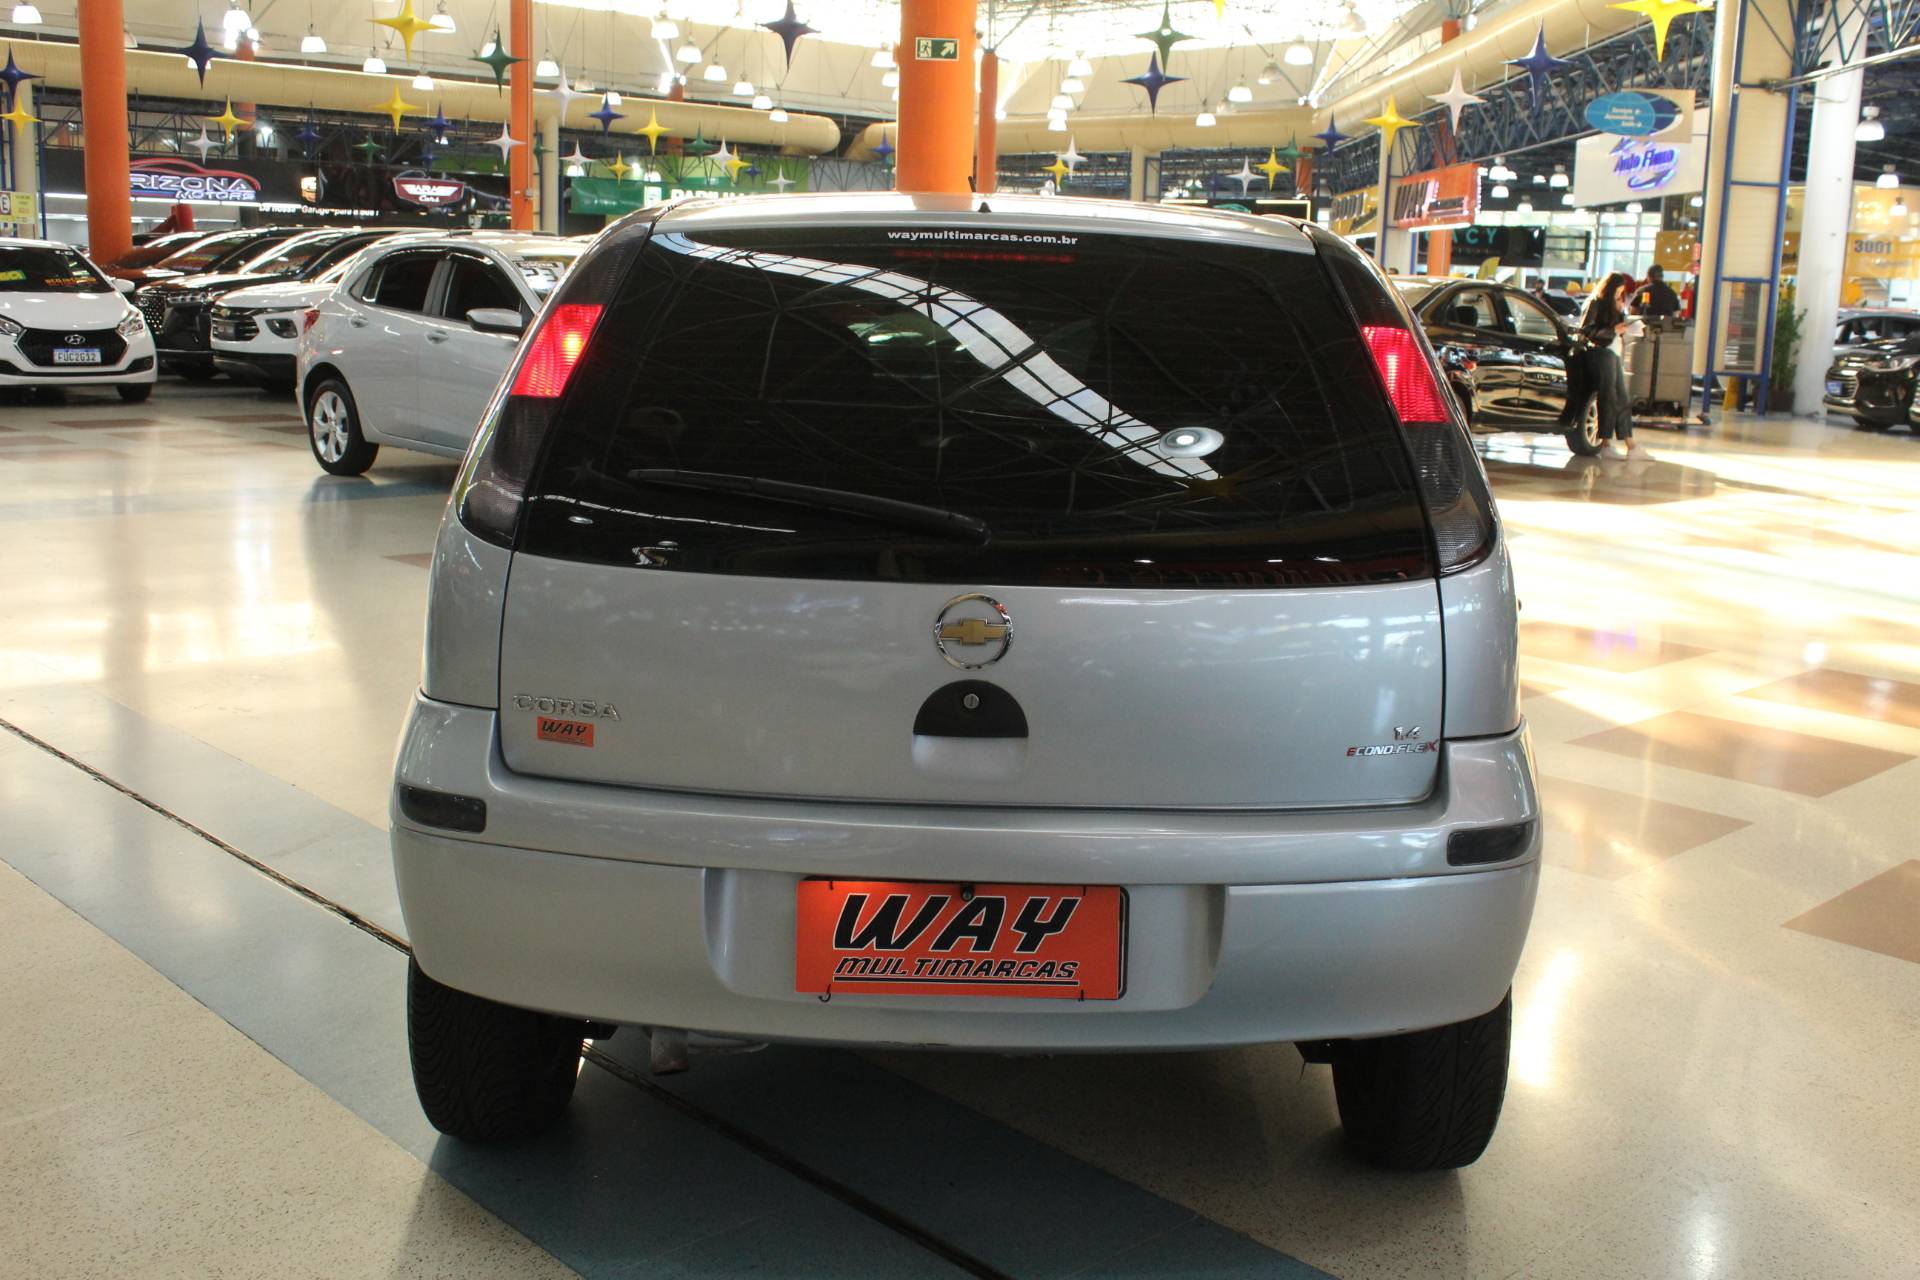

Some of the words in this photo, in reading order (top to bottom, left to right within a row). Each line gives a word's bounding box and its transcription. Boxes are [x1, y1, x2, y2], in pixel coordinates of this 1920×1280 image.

[129, 173, 253, 191] RIZONA
[175, 190, 256, 200] MOTORS
[887, 230, 1079, 245] waymultimarcas.com.br
[1854, 239, 1892, 255] 3001
[513, 695, 621, 721] CORSA
[541, 720, 587, 736] WAY
[833, 893, 1081, 953] WAY
[834, 957, 1080, 979] MULTIMARCAS
